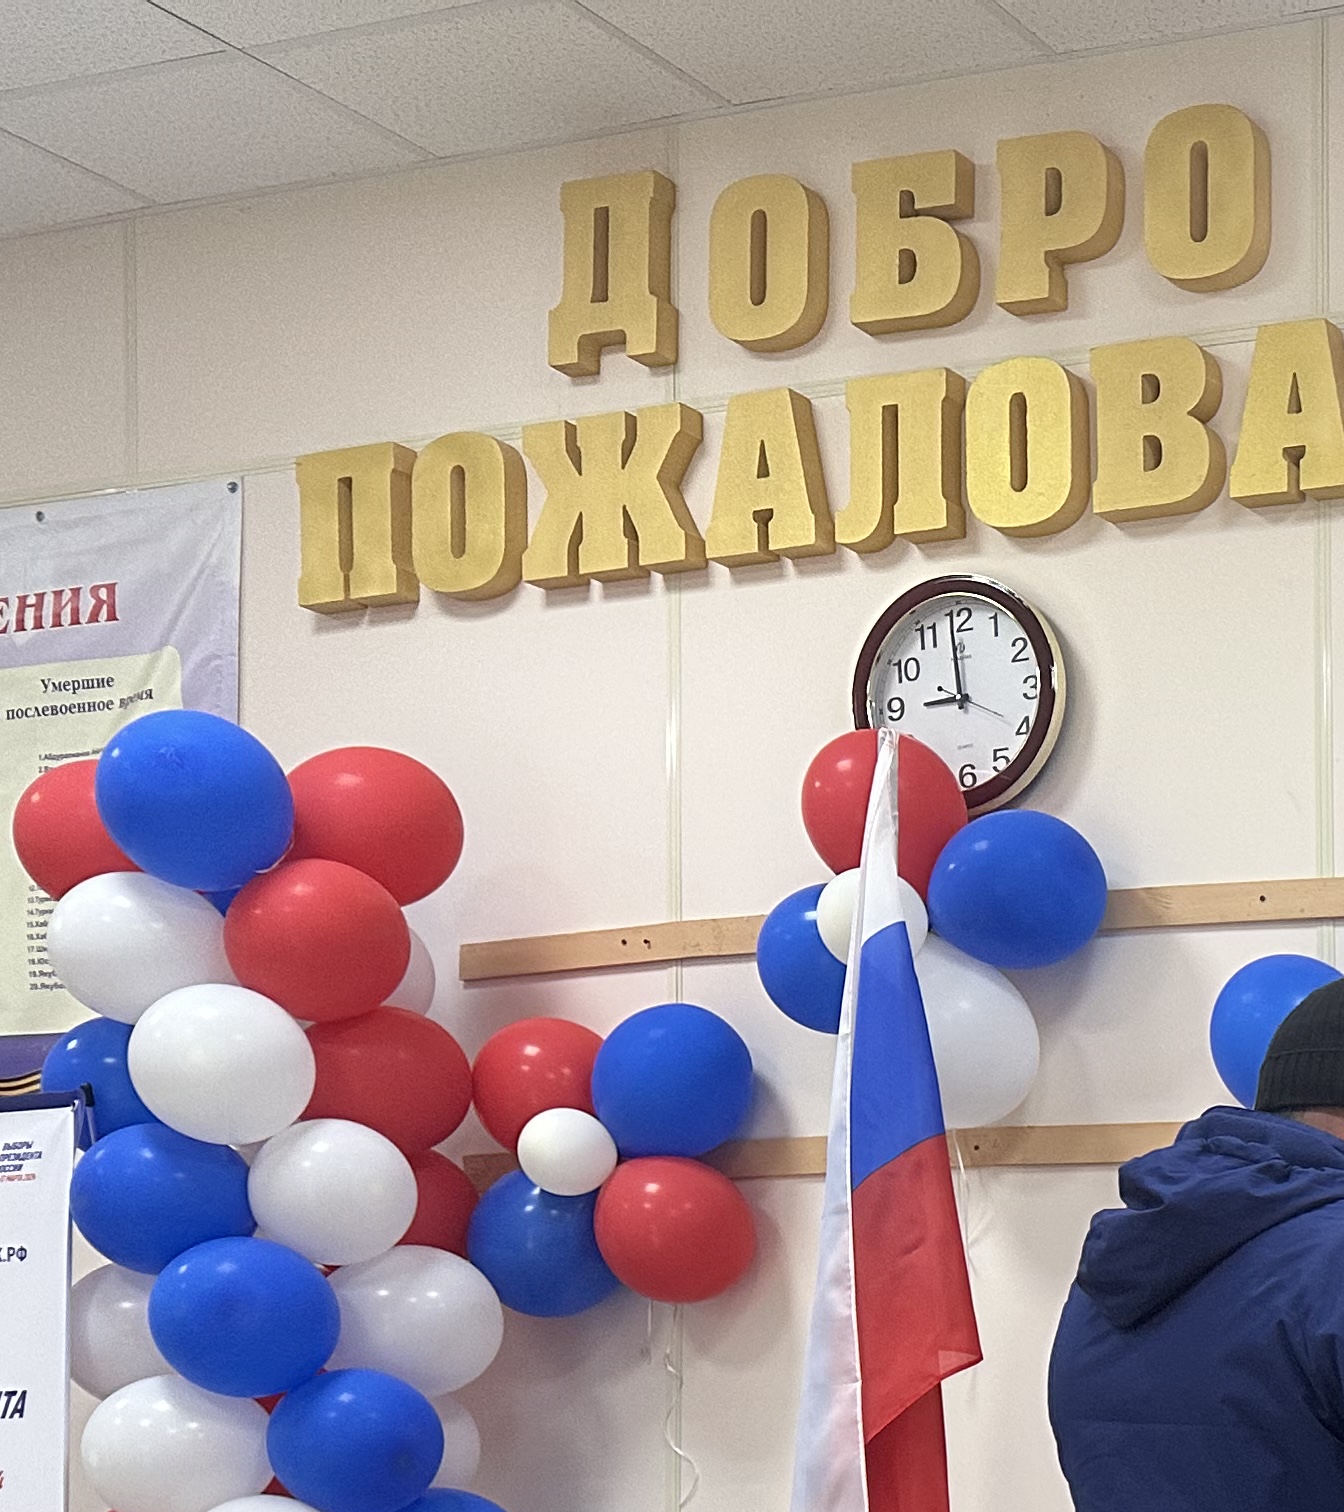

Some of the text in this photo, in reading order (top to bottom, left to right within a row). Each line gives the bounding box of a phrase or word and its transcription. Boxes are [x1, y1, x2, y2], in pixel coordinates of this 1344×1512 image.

[549, 103, 1271, 378] ДОБРО
[915, 622, 938, 650] 11
[1010, 637, 1030, 663] 2
[892, 657, 921, 684] 10
[41, 676, 115, 695] Умершие
[1023, 674, 1038, 700] 3
[6, 699, 115, 721] послевоенное
[887, 697, 905, 721] 9
[1015, 716, 1031, 736] 4
[958, 764, 977, 788] 6
